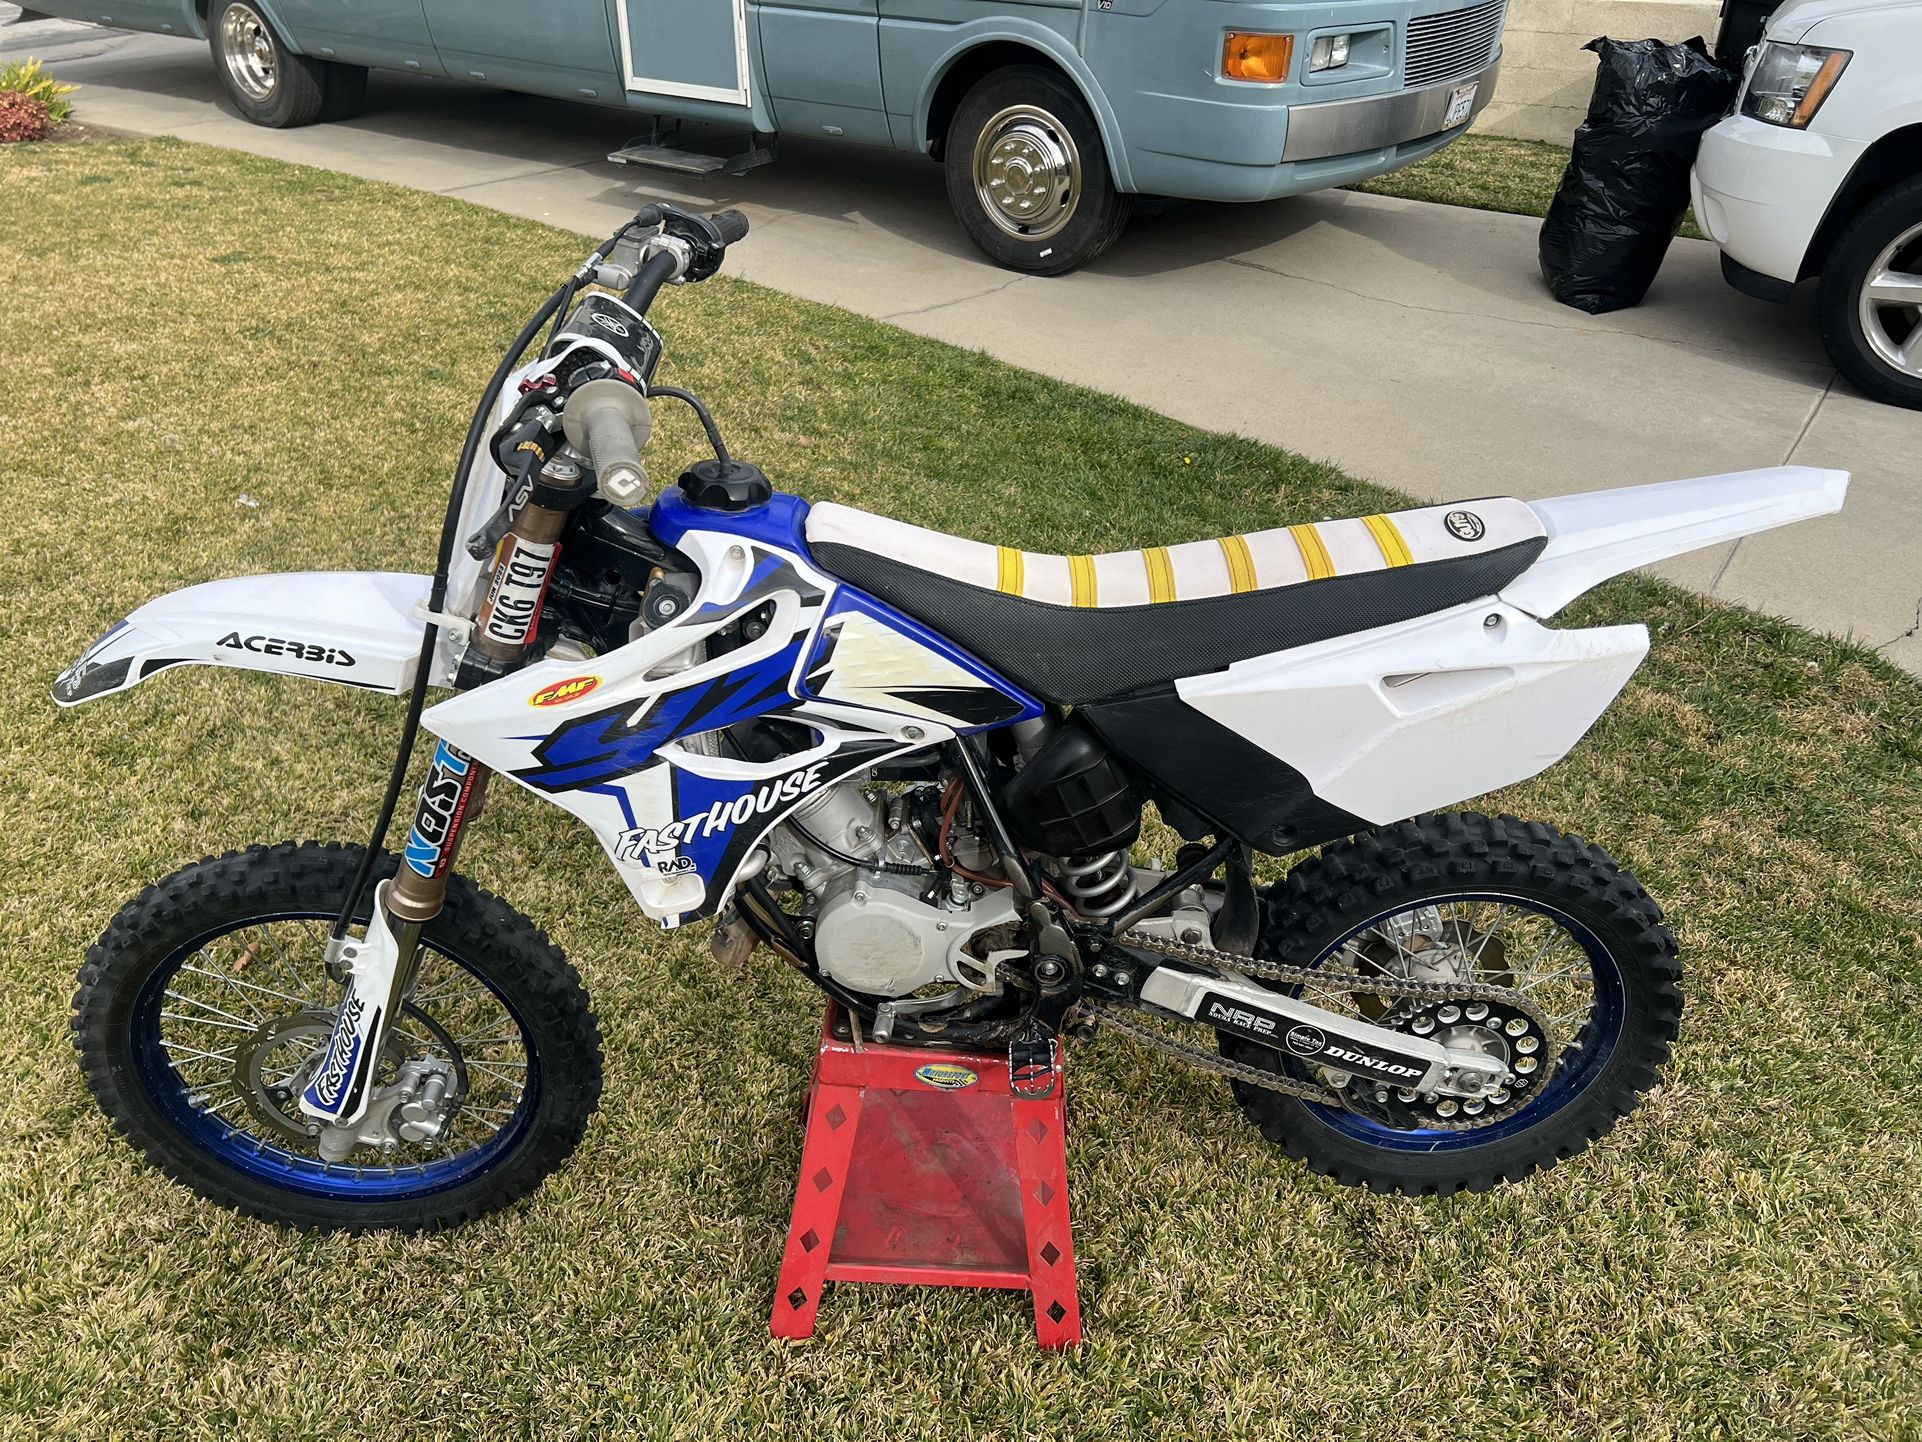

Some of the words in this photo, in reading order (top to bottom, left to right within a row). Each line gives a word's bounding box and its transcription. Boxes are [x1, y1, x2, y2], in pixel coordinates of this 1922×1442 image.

[508, 474, 534, 523] ASV
[504, 546, 551, 589] T97
[488, 595, 535, 641] CK6
[533, 676, 596, 706] FMF
[614, 761, 830, 862] FASTHOUSE
[1209, 1001, 1276, 1030] NRP
[316, 988, 366, 1105] FASTHOUSE
[1324, 1046, 1423, 1078] DUNLOP
